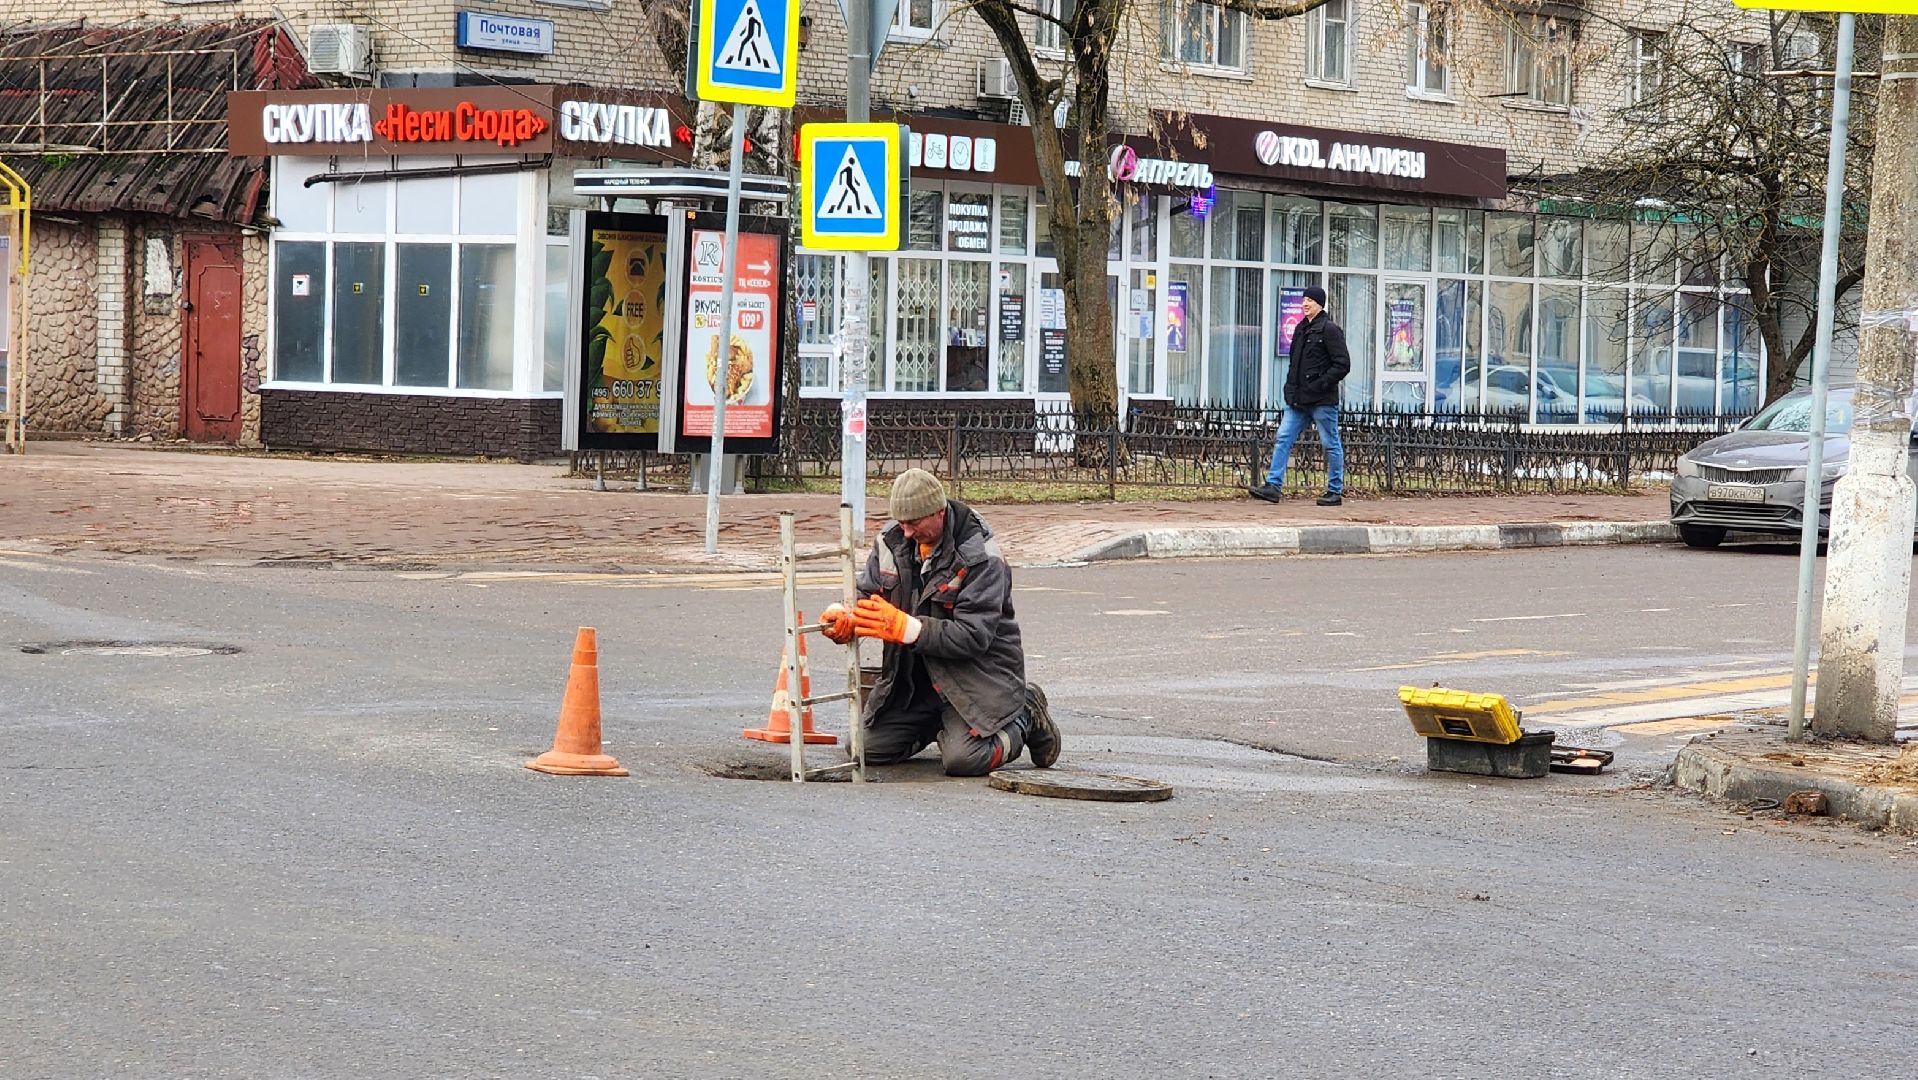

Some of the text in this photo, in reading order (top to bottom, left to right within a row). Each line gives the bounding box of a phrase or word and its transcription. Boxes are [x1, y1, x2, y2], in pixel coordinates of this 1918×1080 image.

[480, 19, 540, 38] Почтовая
[263, 101, 548, 147] СКУПКА «Неси Сюда»
[560, 100, 672, 148] СКУПКА
[1279, 136, 1426, 179] KDL АНАЛИЗЫ
[1133, 158, 1214, 188] АПРЕЛЬ
[949, 203, 989, 216] ПОКУПКА
[948, 220, 989, 233] ПРОДАЖА
[958, 236, 988, 249] ОБМЕН
[626, 302, 644, 317] FREE
[694, 299, 721, 315] ВКУСН
[592, 387, 609, 399] (495)
[612, 380, 634, 398] 660
[637, 380, 653, 398] 37
